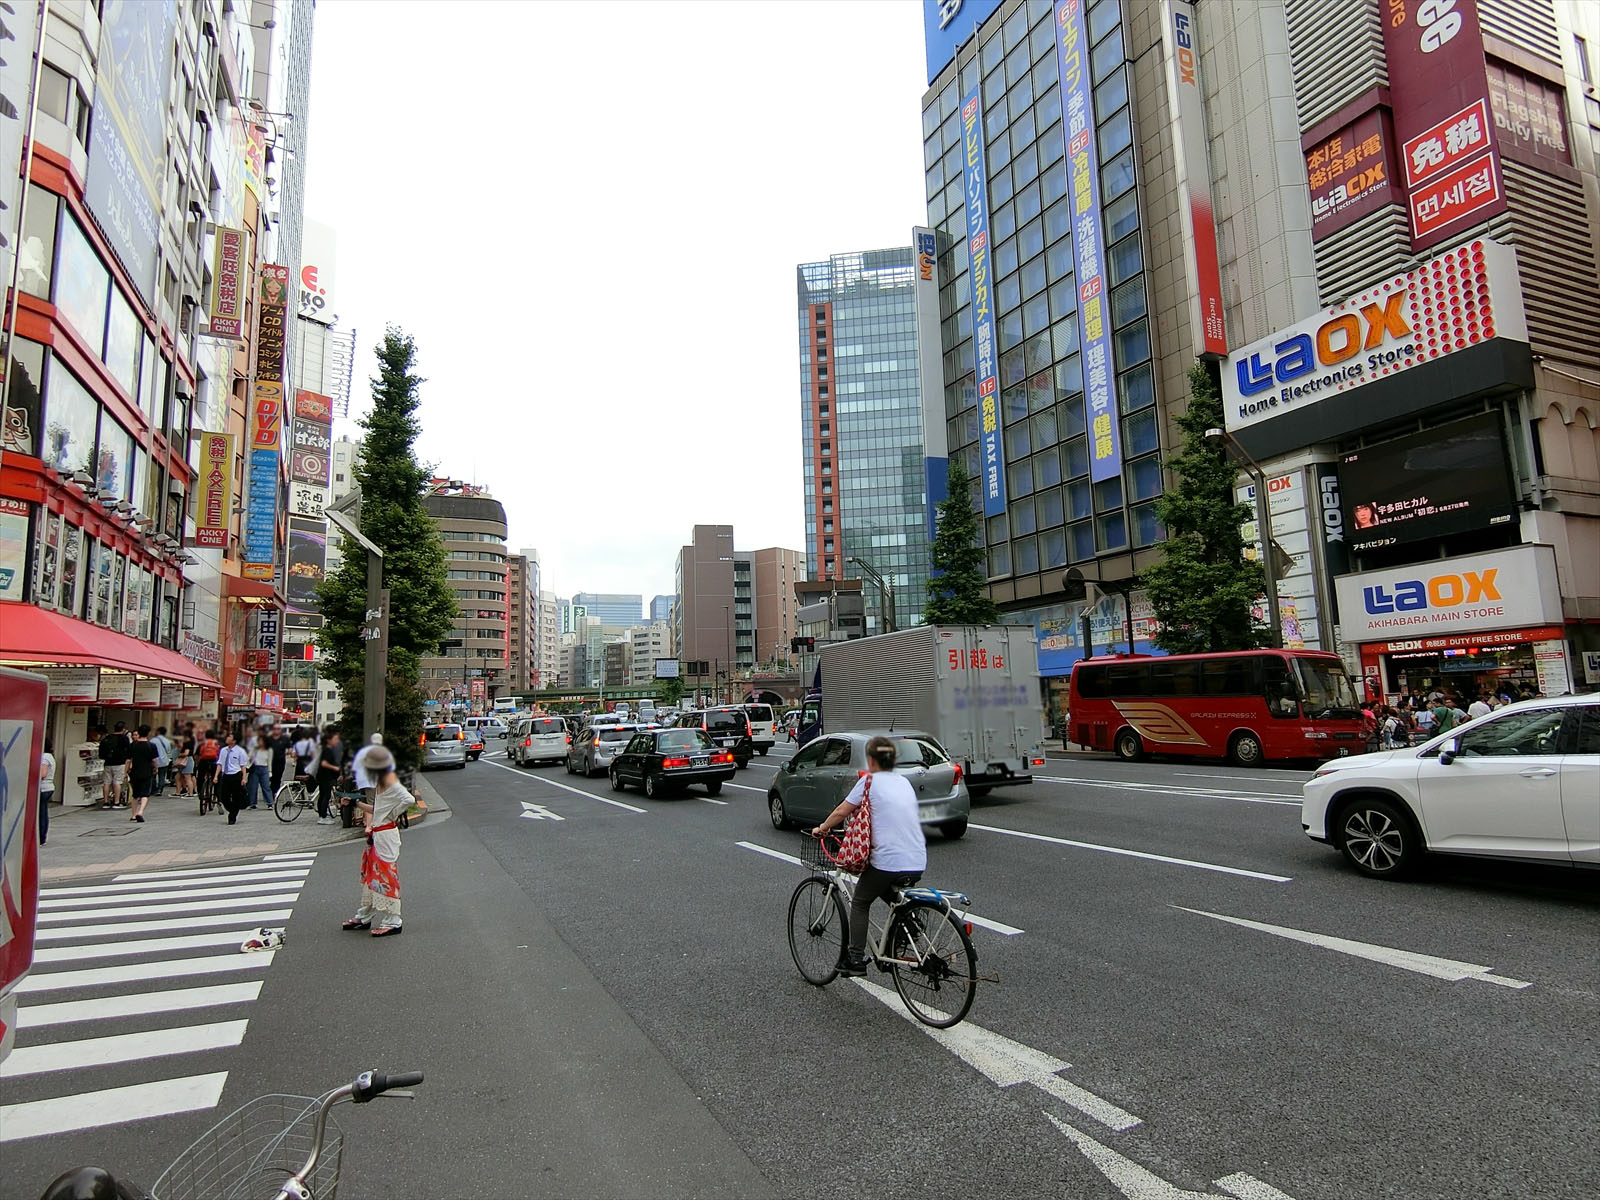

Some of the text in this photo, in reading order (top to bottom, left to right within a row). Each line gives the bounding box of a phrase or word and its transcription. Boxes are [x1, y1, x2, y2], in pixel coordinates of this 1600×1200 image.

[964, 98, 977, 119] 3F
[1491, 90, 1563, 134] Flagship
[1495, 112, 1566, 152] Duty Free
[1060, 1, 1078, 20] 6F
[1071, 132, 1088, 154] 5F
[1082, 279, 1100, 299] 4F
[1307, 136, 1342, 170] 本店
[1411, 113, 1482, 175] 免税
[1309, 133, 1382, 190] 総合家電
[1314, 180, 1388, 224] Home Electronics Store
[1416, 167, 1492, 223] 면세점
[972, 232, 985, 252] 2F
[218, 231, 240, 316] 愛客旺免税店
[262, 305, 284, 316] ゲーム
[263, 316, 282, 326] CD
[1209, 297, 1218, 339] Electronics
[213, 318, 239, 327] AKKY
[215, 325, 236, 334] ONE
[260, 326, 284, 337] アイドル
[259, 337, 284, 348] アニメ
[258, 349, 282, 359] コミック
[259, 360, 281, 369] ホビー
[257, 370, 281, 380] フィギュア
[1238, 342, 1415, 418] Home Electronics Store
[981, 379, 993, 396] 1F
[255, 400, 279, 446] DVD
[982, 395, 997, 434] 免税
[209, 437, 226, 458] 免税
[295, 431, 330, 450] 甘太郎
[986, 433, 997, 465] TAX
[208, 460, 225, 488] TAX
[988, 465, 999, 499] FREE
[207, 489, 223, 526] FREE
[1377, 496, 1429, 515] 宇多田ヒカル
[1393, 513, 1414, 522] ALBUM
[199, 529, 226, 537] AKKY
[201, 536, 222, 544] ONE
[1353, 537, 1397, 551] アキバビジョン
[1367, 606, 1505, 630] AKIHABARA MAIN STORE
[1450, 637, 1470, 646] DUTY
[1471, 635, 1493, 644] FREE
[1494, 633, 1522, 642] STORE
